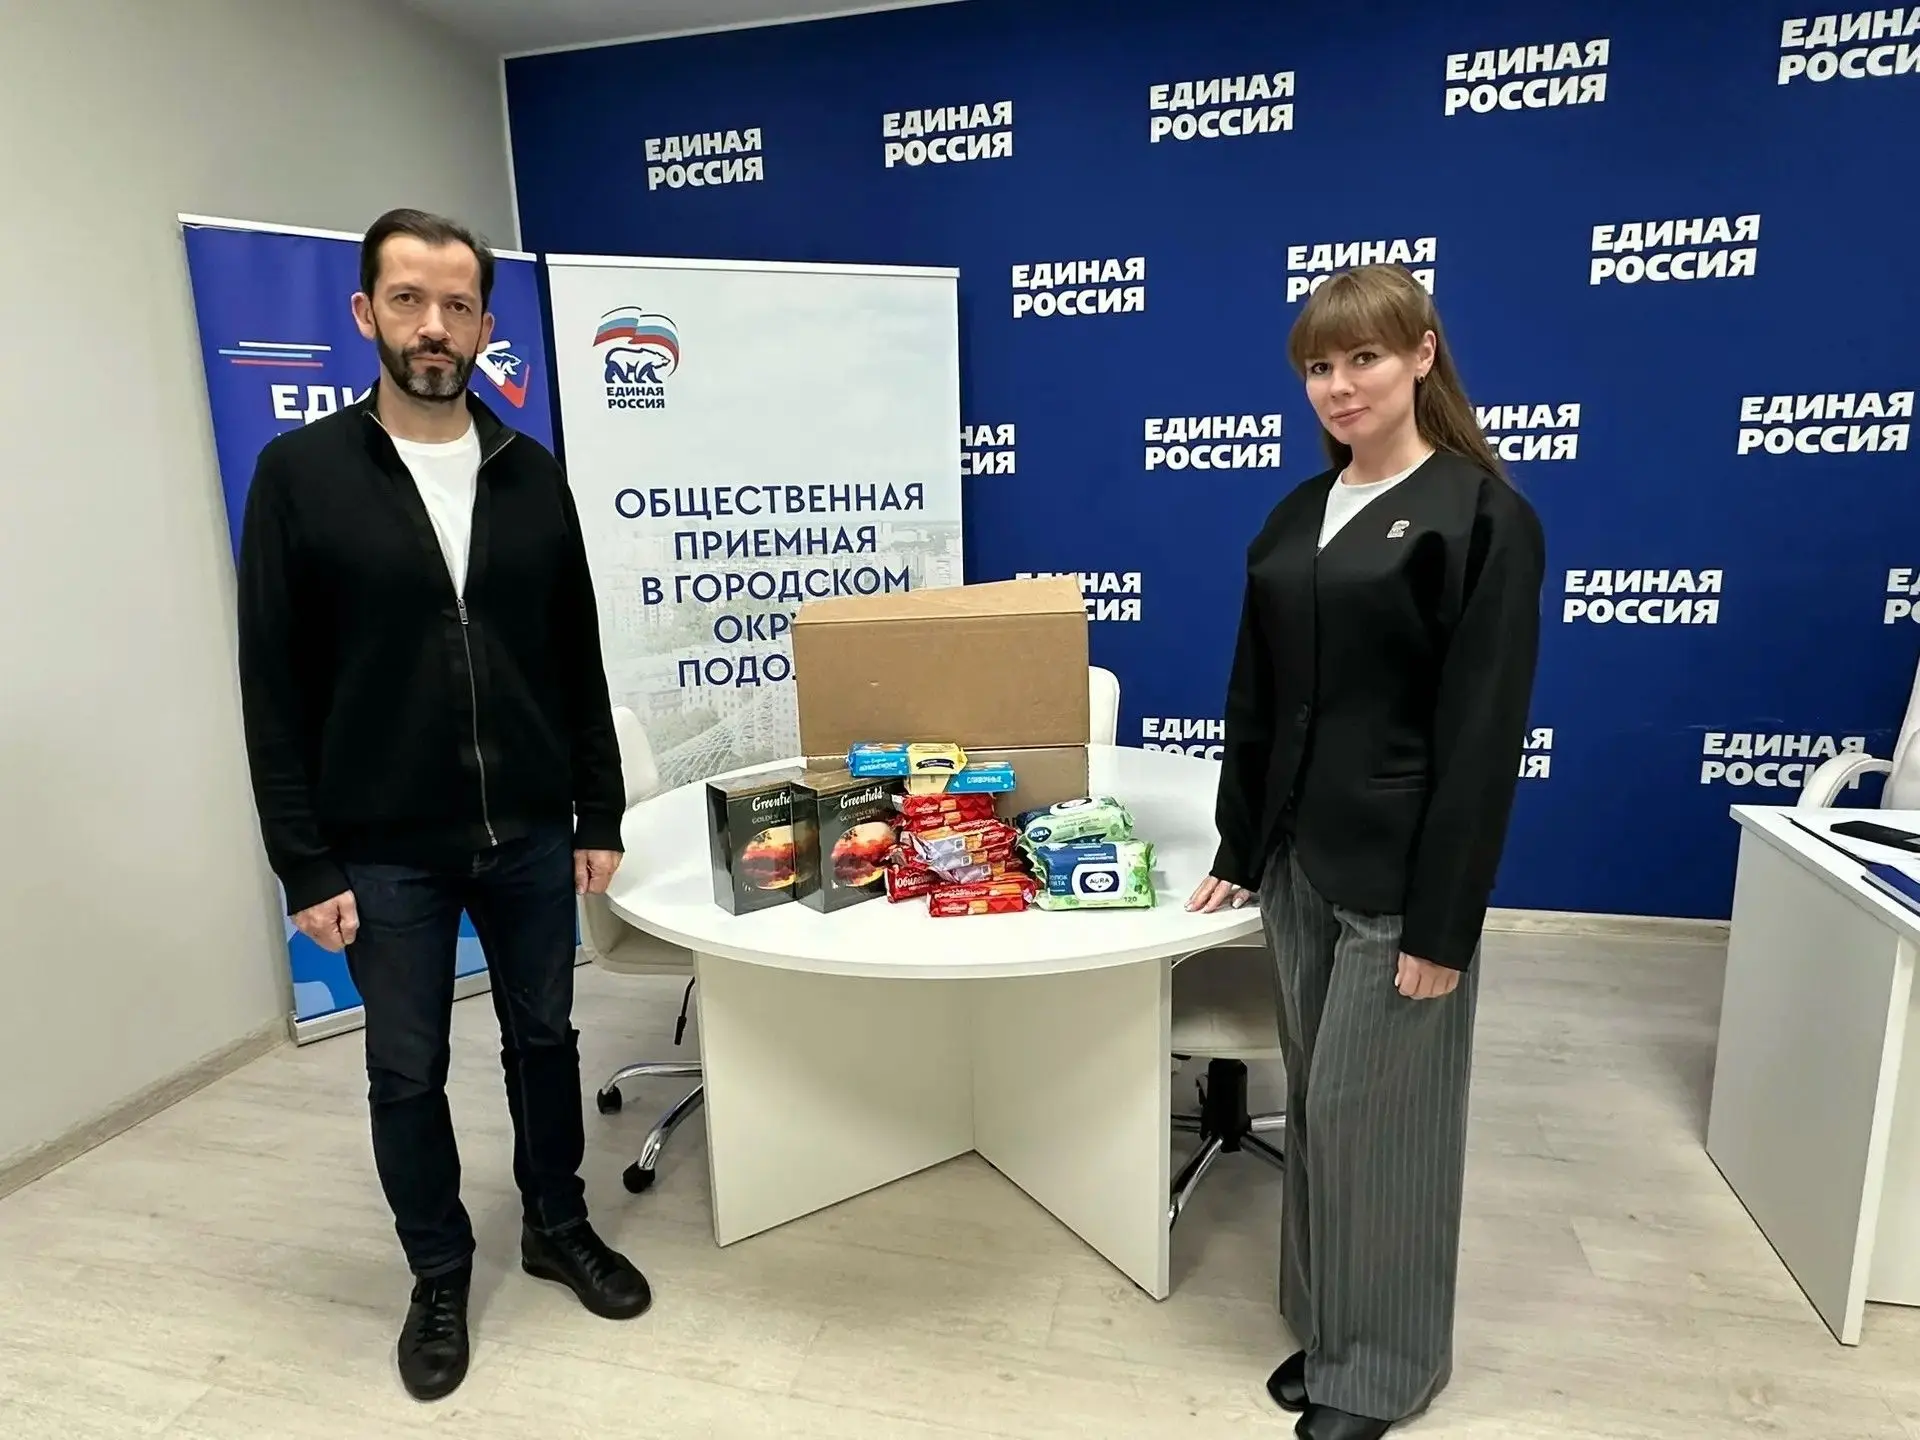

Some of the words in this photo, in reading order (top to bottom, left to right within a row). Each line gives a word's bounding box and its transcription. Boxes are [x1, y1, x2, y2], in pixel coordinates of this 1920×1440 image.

[1445, 39, 1609, 82] ЕДИНАЯ
[1149, 71, 1295, 111] ЕДИНАЯ
[1444, 73, 1606, 115] РОССИЯ
[884, 101, 1013, 138] ЕДИНАЯ
[1150, 104, 1293, 142] РОССИЯ
[644, 128, 762, 162] ЕДИНАЯ
[885, 131, 1013, 167] РОССИЯ
[647, 156, 763, 190] РОССИЯ
[1591, 215, 1760, 253] ЕДИНАЯ
[1286, 237, 1437, 272] ЕДИНАЯ
[1590, 248, 1758, 285] РОССИЯ
[1012, 257, 1145, 290] ЕДИНАЯ
[1013, 287, 1145, 318] РОССИЯ
[606, 386, 664, 397] ЕДИНАЯ
[608, 399, 665, 409] РОССИЯ
[1739, 392, 1915, 424] ЕДИНАЯ
[1144, 414, 1282, 443] ЕДИНАЯ
[1737, 424, 1911, 455] РОССИЯ
[1145, 443, 1281, 470] РОССИЯ
[614, 482, 925, 521] ОБЩЕСТВЕННАЯ
[674, 525, 877, 560] ПРИЕМНАЯ
[642, 577, 664, 605] В
[675, 565, 910, 603] ГОРОДСКОМ
[1565, 569, 1723, 595] ЕДИНАЯ
[713, 612, 797, 643] ОКР
[1562, 598, 1720, 624] РОССИЯ
[678, 654, 797, 688] ПОДО
[1703, 732, 1866, 759] ЕДИНАЯ
[840, 786, 883, 809] Greenfield
[1030, 829, 1049, 838] AURA
